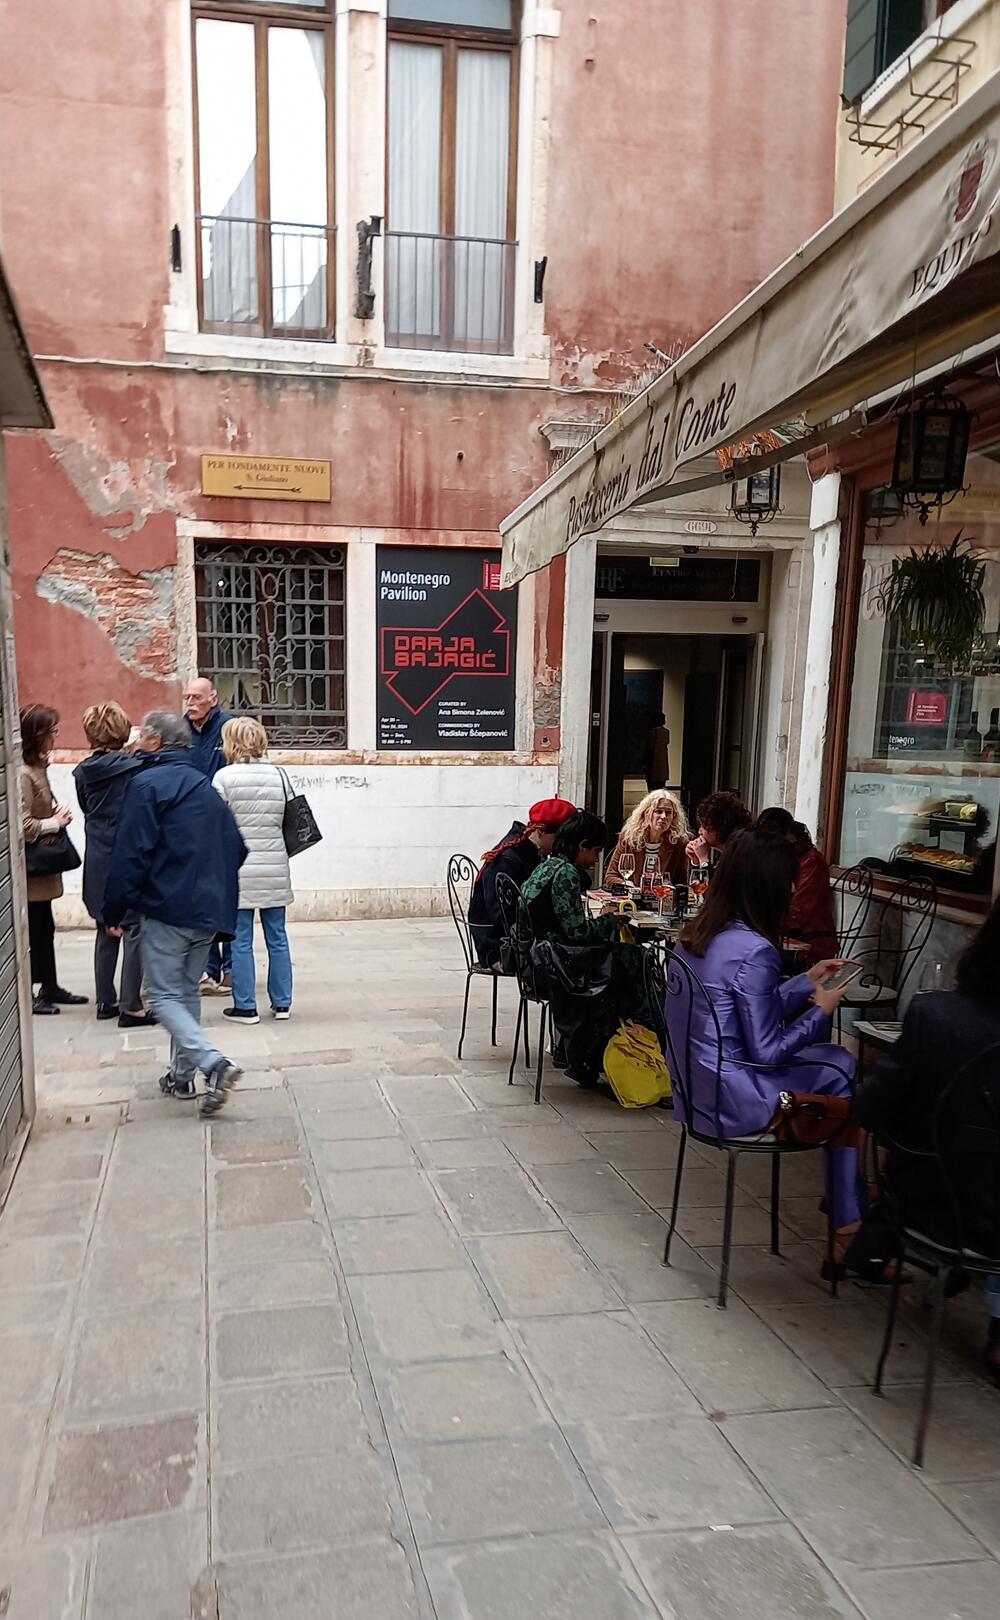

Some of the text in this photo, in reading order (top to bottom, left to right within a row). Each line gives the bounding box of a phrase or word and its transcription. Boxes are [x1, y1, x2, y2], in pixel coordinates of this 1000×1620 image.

[635, 412, 671, 491] dal
[675, 382, 737, 461] Conte
[207, 460, 225, 469] PER
[380, 570, 451, 589] Montenegro
[380, 586, 427, 601] Pavilion
[394, 635, 475, 652] DARJA
[394, 649, 496, 668] BAJAGIĆ
[438, 708, 451, 716] Ana
[452, 708, 475, 716] Simona
[438, 729, 469, 737] Vladislav
